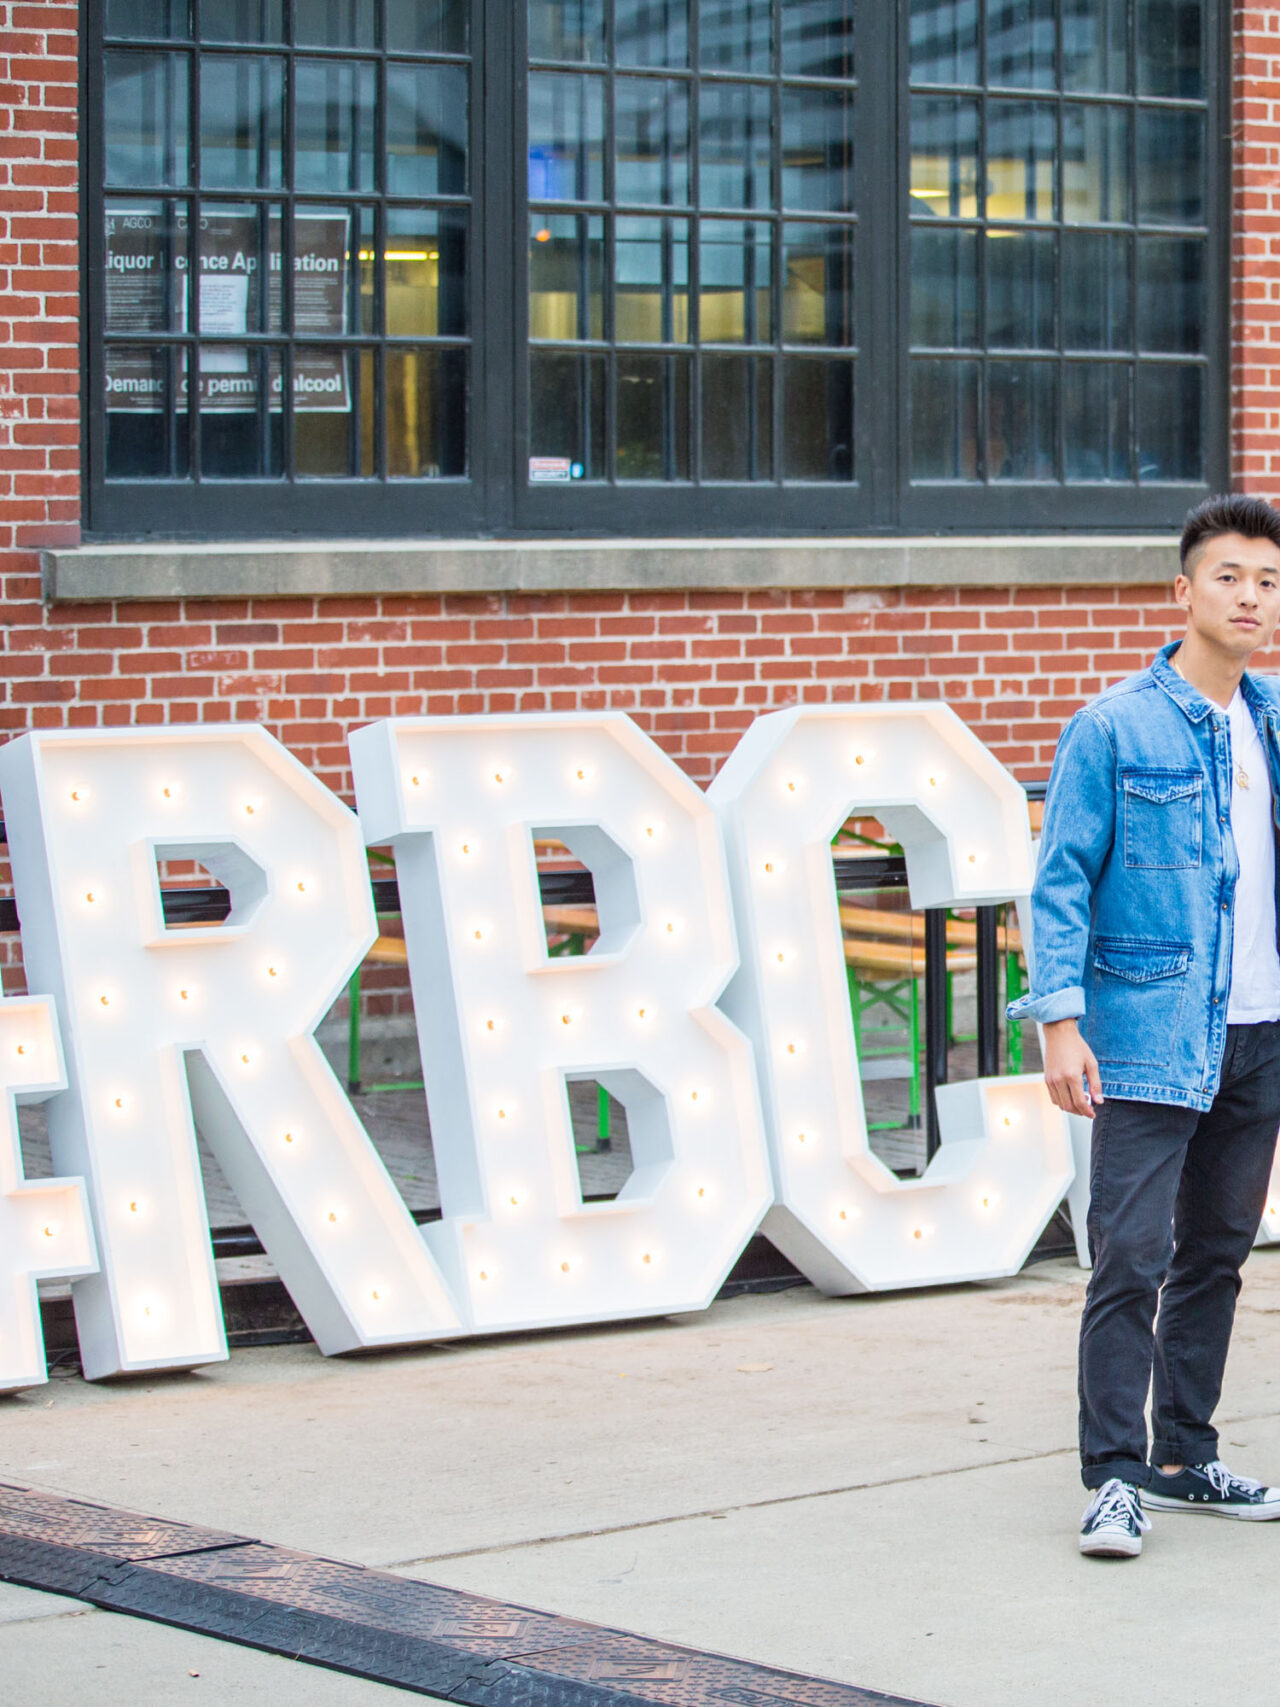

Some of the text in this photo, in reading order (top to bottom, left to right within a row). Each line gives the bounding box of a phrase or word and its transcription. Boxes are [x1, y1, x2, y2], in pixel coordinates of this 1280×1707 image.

[123, 217, 152, 229] AGCO
[104, 250, 155, 274] iquor
[231, 250, 339, 276] Apliation
[208, 374, 258, 397] permi
